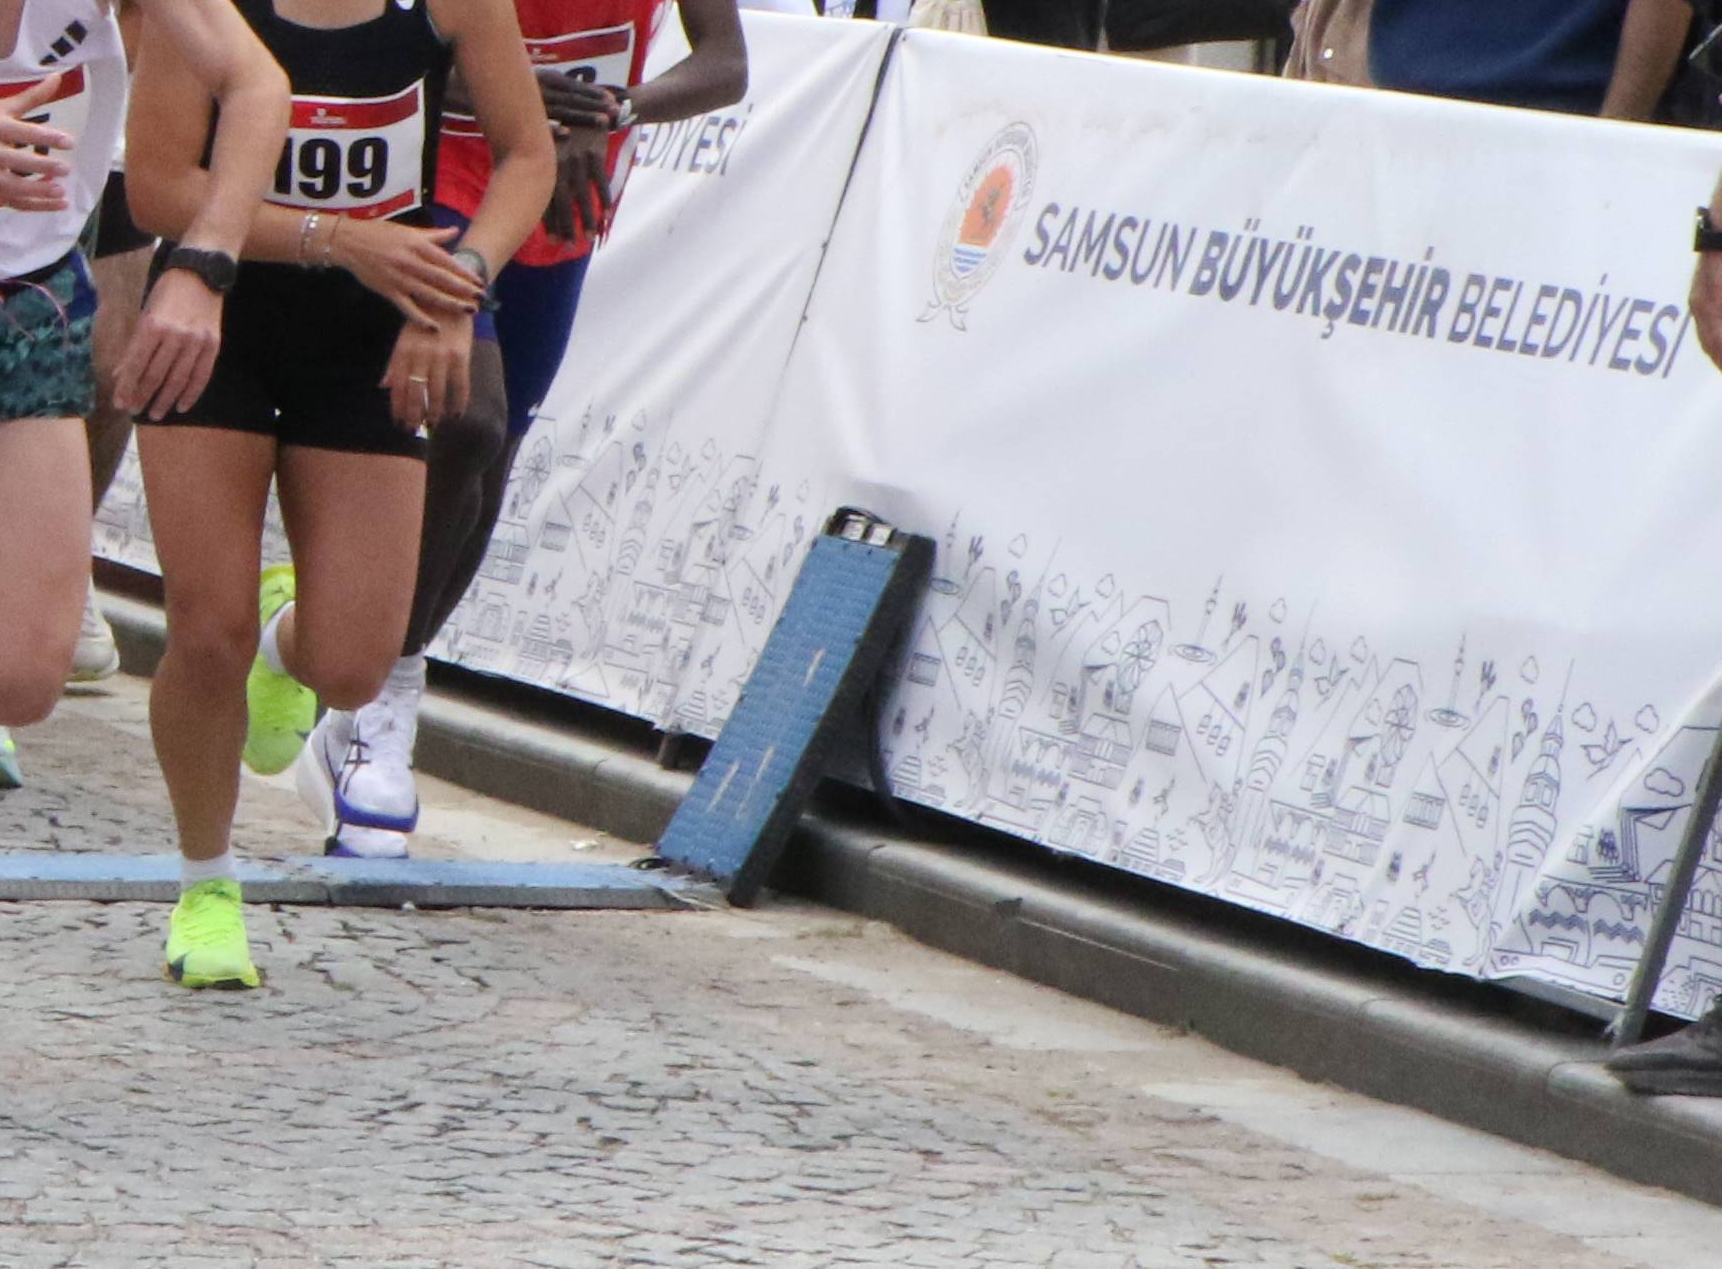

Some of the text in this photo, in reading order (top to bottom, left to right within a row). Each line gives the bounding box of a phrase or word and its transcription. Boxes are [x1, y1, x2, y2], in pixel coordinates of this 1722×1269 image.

[274, 136, 389, 199] 199
[1023, 202, 1692, 379] SAMSUN BÜYÜKŞEHİR BELEDİYESİ
